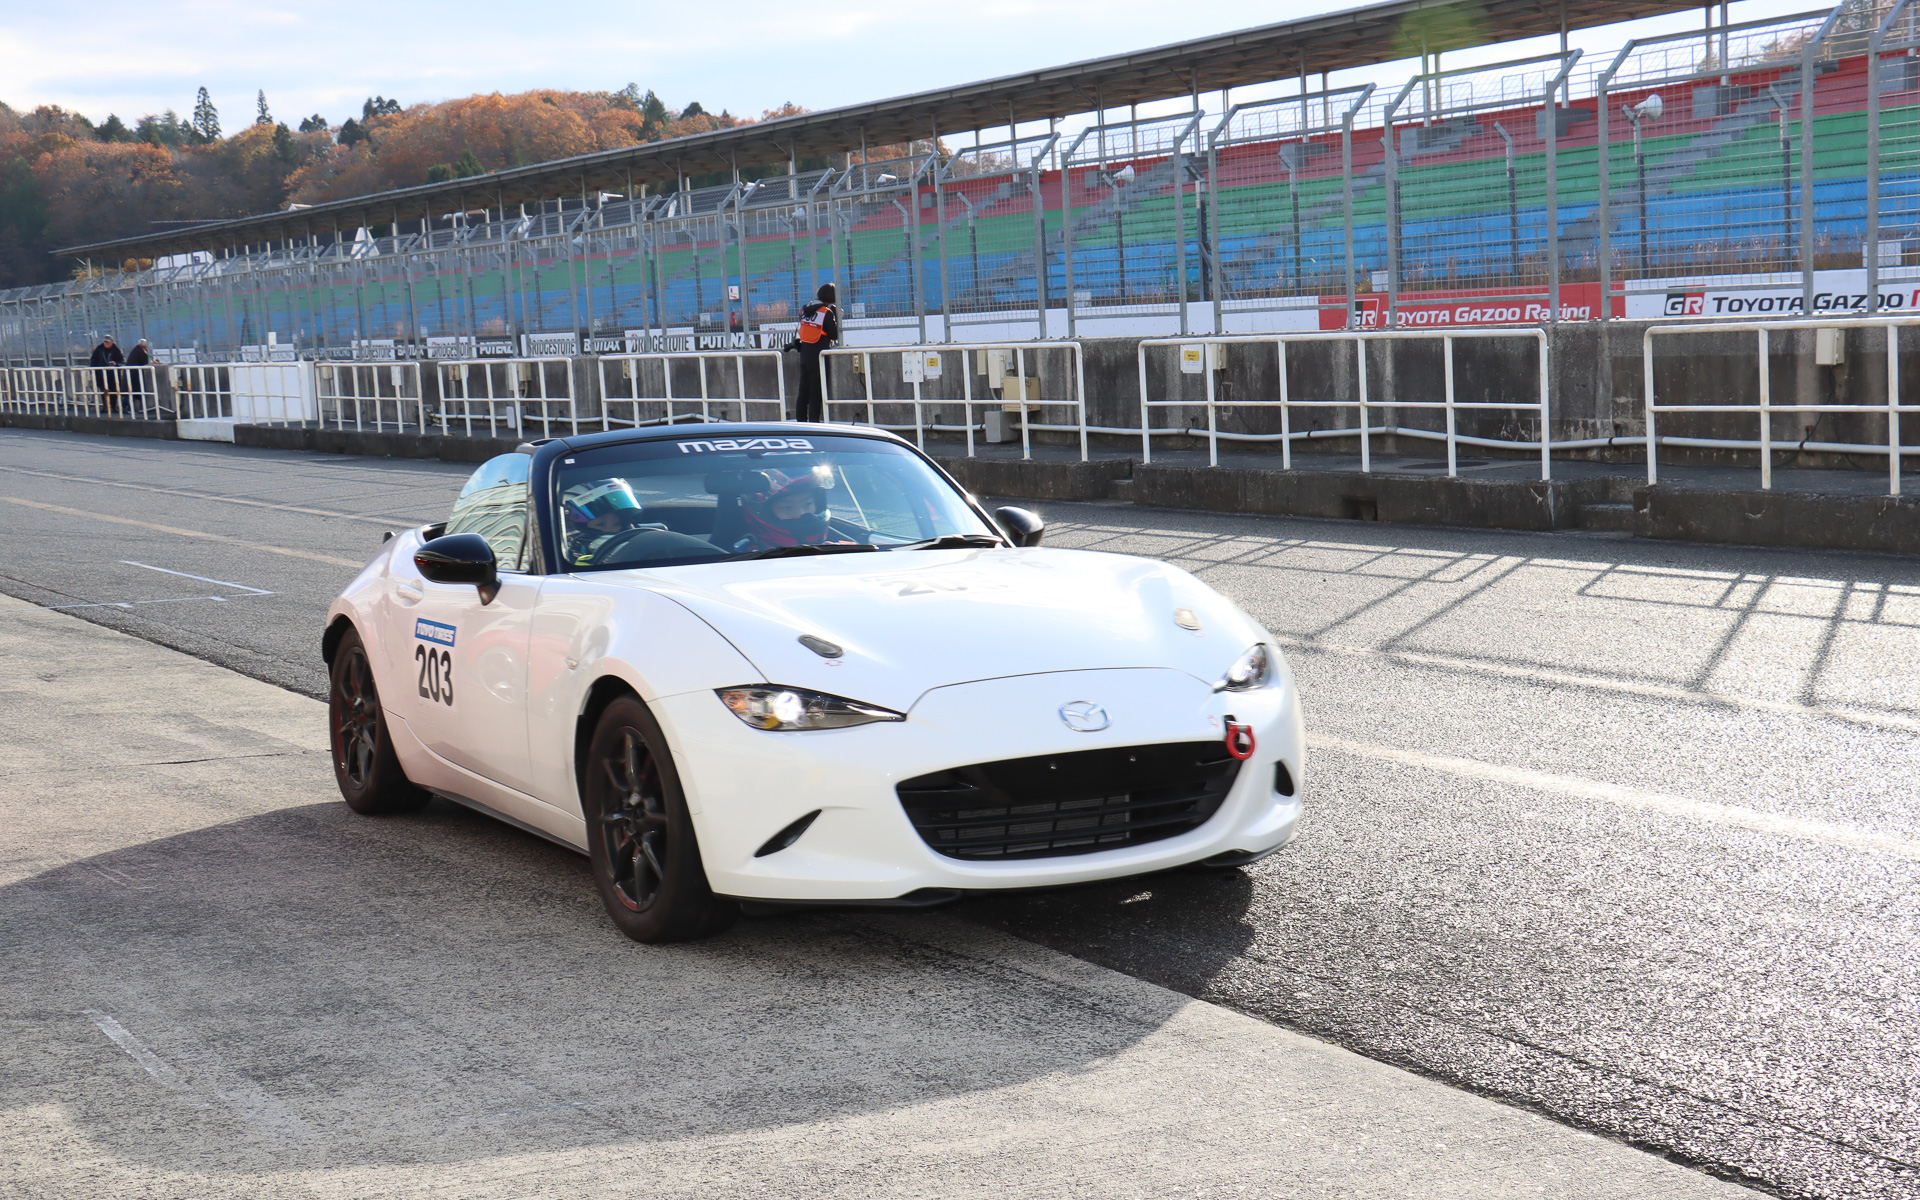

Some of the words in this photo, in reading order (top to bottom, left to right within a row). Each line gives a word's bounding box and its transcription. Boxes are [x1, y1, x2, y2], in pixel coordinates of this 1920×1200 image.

[1382, 310, 1450, 325] TOYOTA
[1454, 306, 1521, 323] GAZOO
[1524, 302, 1591, 321] Raing
[1664, 297, 1704, 315] GR
[1712, 296, 1804, 313] TOYOTA
[416, 623, 434, 638] TOYO
[433, 627, 455, 643] TIRES
[415, 643, 453, 707] 203
